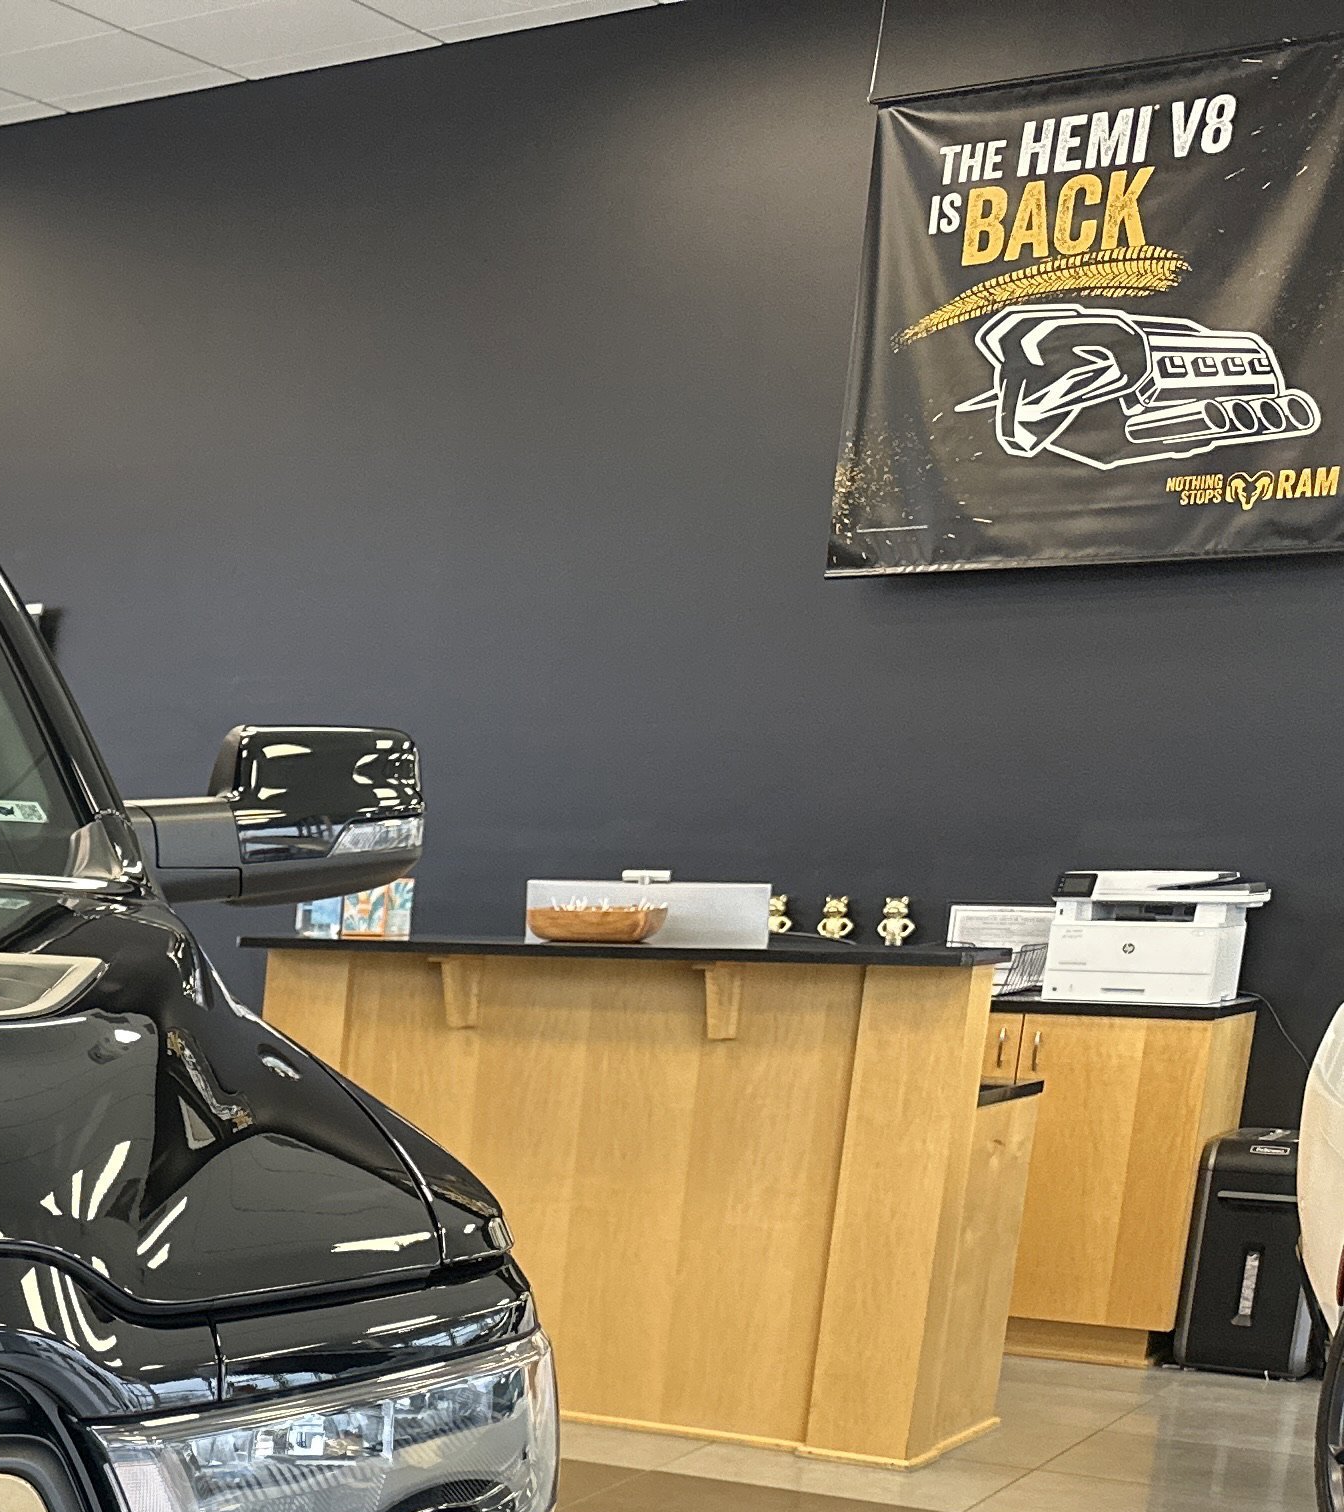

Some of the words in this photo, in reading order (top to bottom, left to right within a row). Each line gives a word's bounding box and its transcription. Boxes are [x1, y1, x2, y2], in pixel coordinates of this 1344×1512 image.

[939, 139, 1008, 185] THE
[1016, 105, 1154, 178] HEMI
[1171, 94, 1237, 158] V8
[928, 192, 963, 236] IS
[962, 165, 1156, 267] BACK
[1165, 473, 1224, 492] NOTHING
[1179, 489, 1222, 506] STOPS
[1275, 465, 1341, 500] RAM
